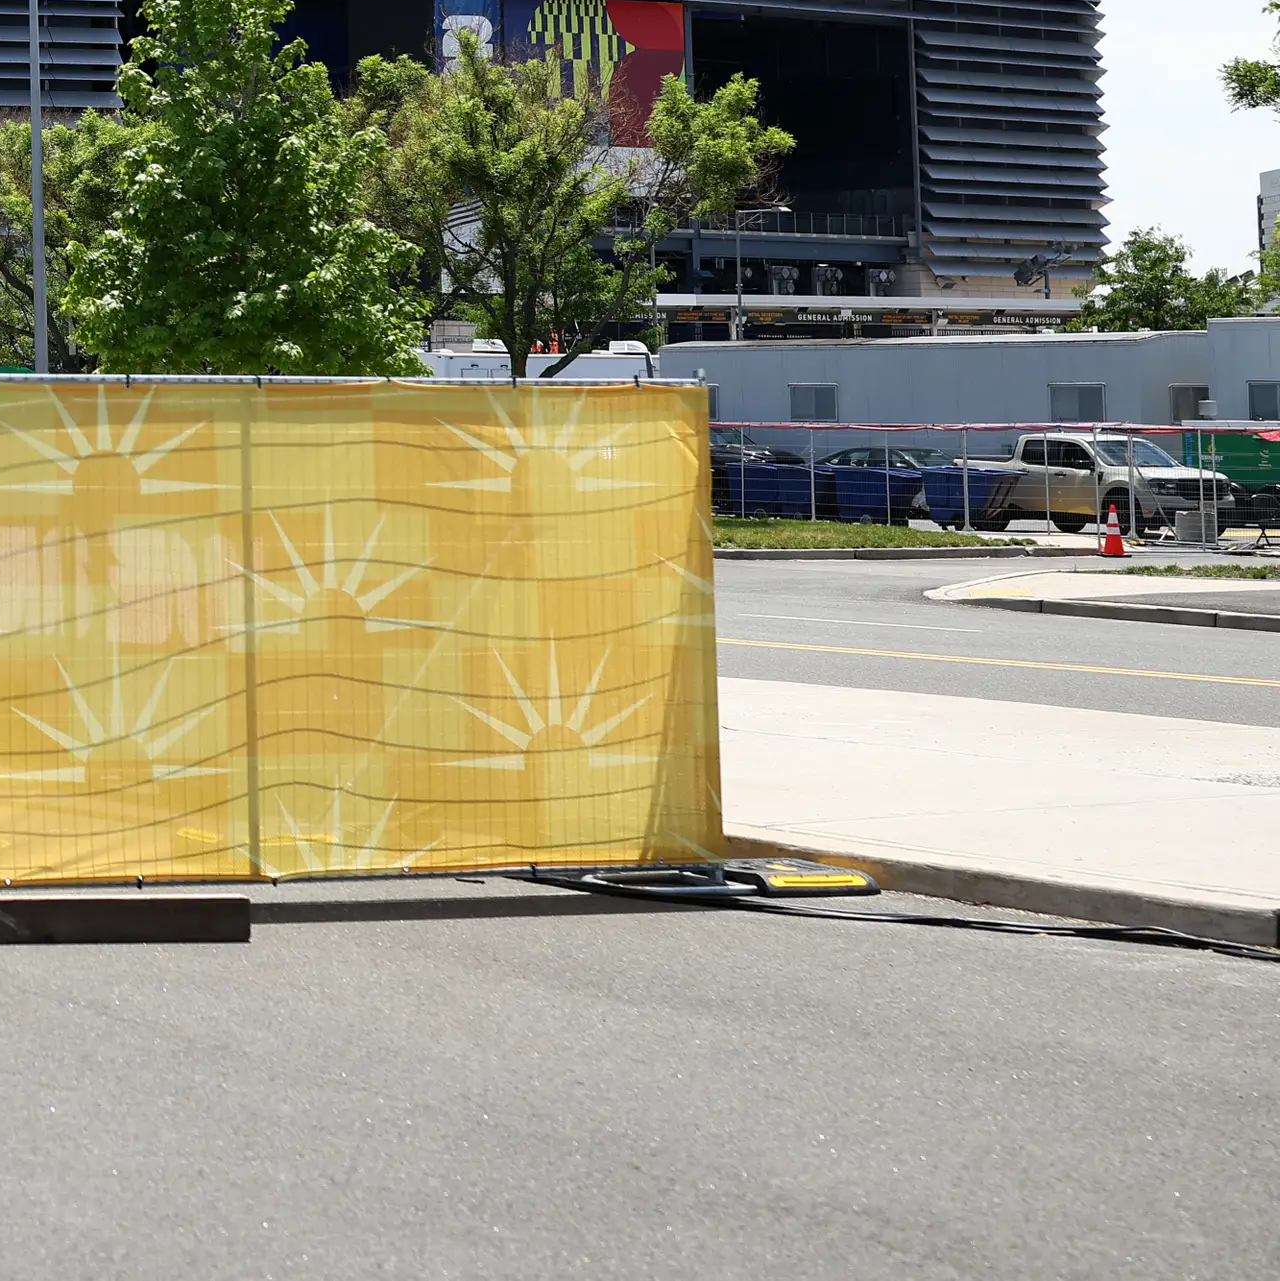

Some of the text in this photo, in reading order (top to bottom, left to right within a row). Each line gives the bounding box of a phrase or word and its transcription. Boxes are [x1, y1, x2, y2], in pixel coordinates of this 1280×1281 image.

[797, 314, 831, 322] GENERAL
[833, 314, 873, 322] ADMISSION
[993, 316, 1024, 324] GENERAL
